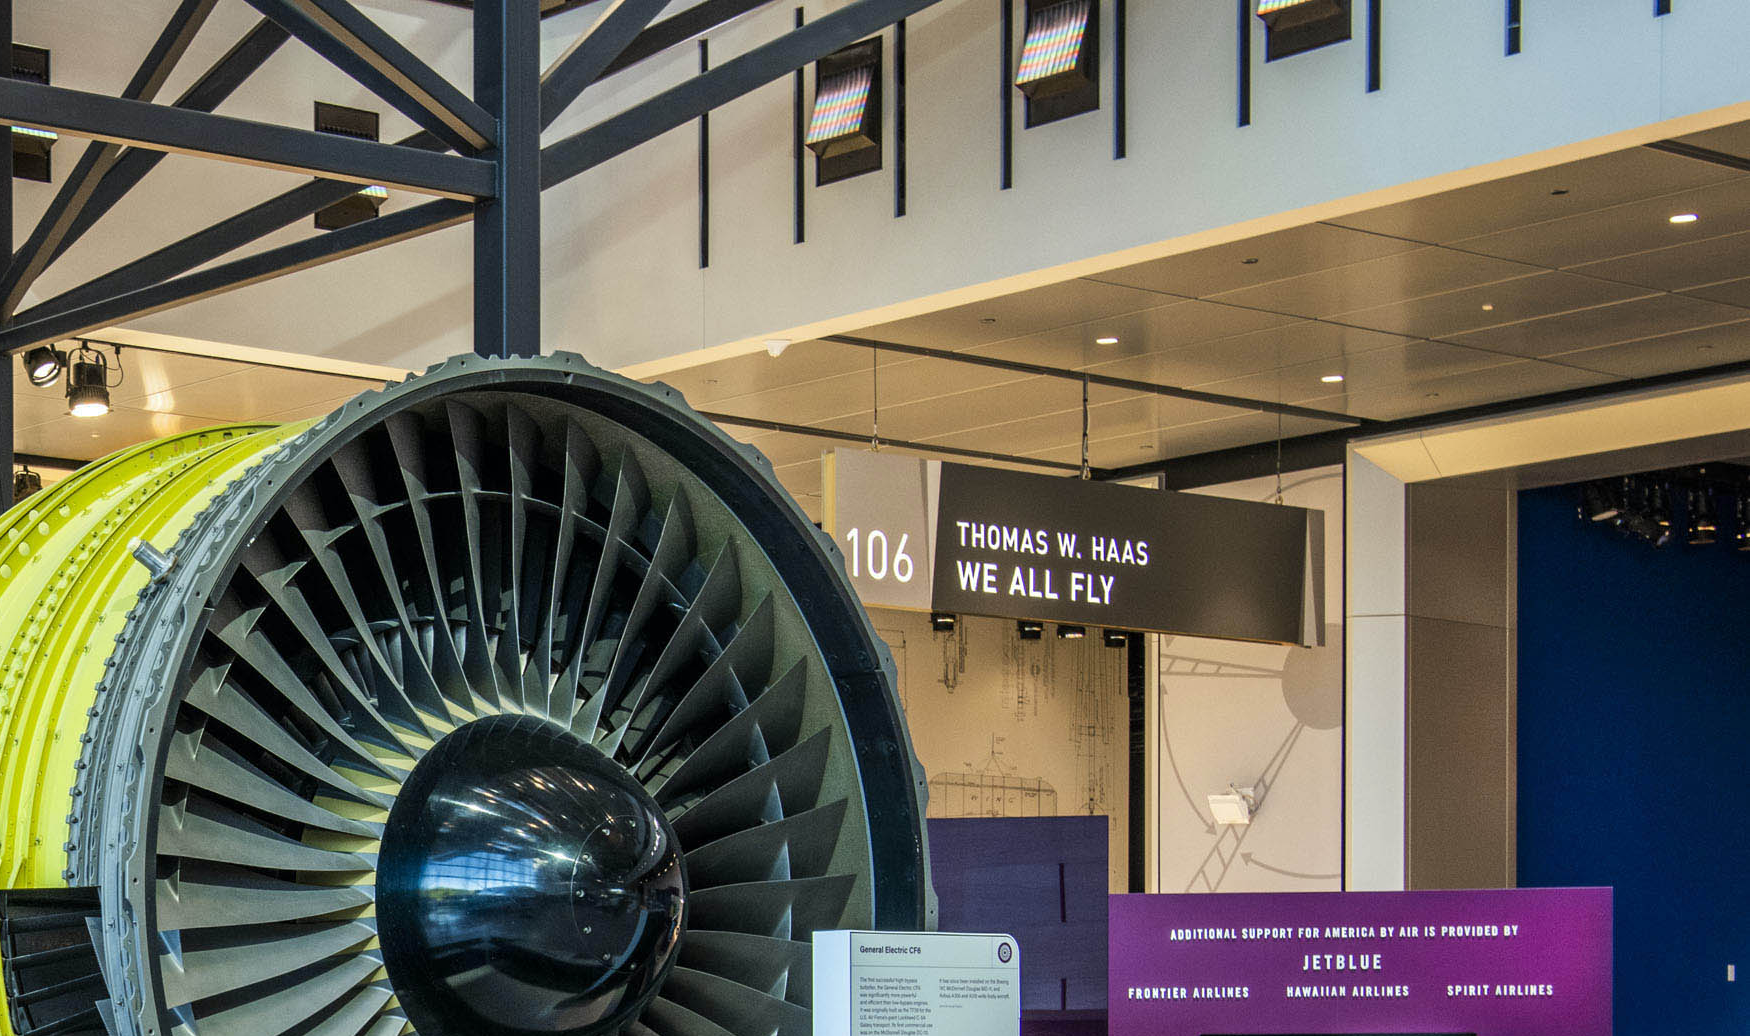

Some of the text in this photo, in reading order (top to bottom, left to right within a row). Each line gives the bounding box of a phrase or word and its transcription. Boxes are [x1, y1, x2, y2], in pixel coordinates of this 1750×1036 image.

[957, 522, 1147, 565] THOMAS W. HAAS
[846, 527, 914, 583] 106
[957, 561, 1113, 604] WE ALL FLY
[1171, 925, 1518, 940] ADDITIONAL SUPPORT FOR AMERICA BY AIR IS PROVIDED BY
[859, 946, 921, 954] General Electric CF6
[1303, 955, 1382, 970] JETBLUE
[1128, 987, 1249, 999] FRONTIER AIRLINES
[1287, 986, 1409, 997] HAWAIIAN AIRLINES
[1448, 984, 1553, 996] SPIRIT AIRLINES
